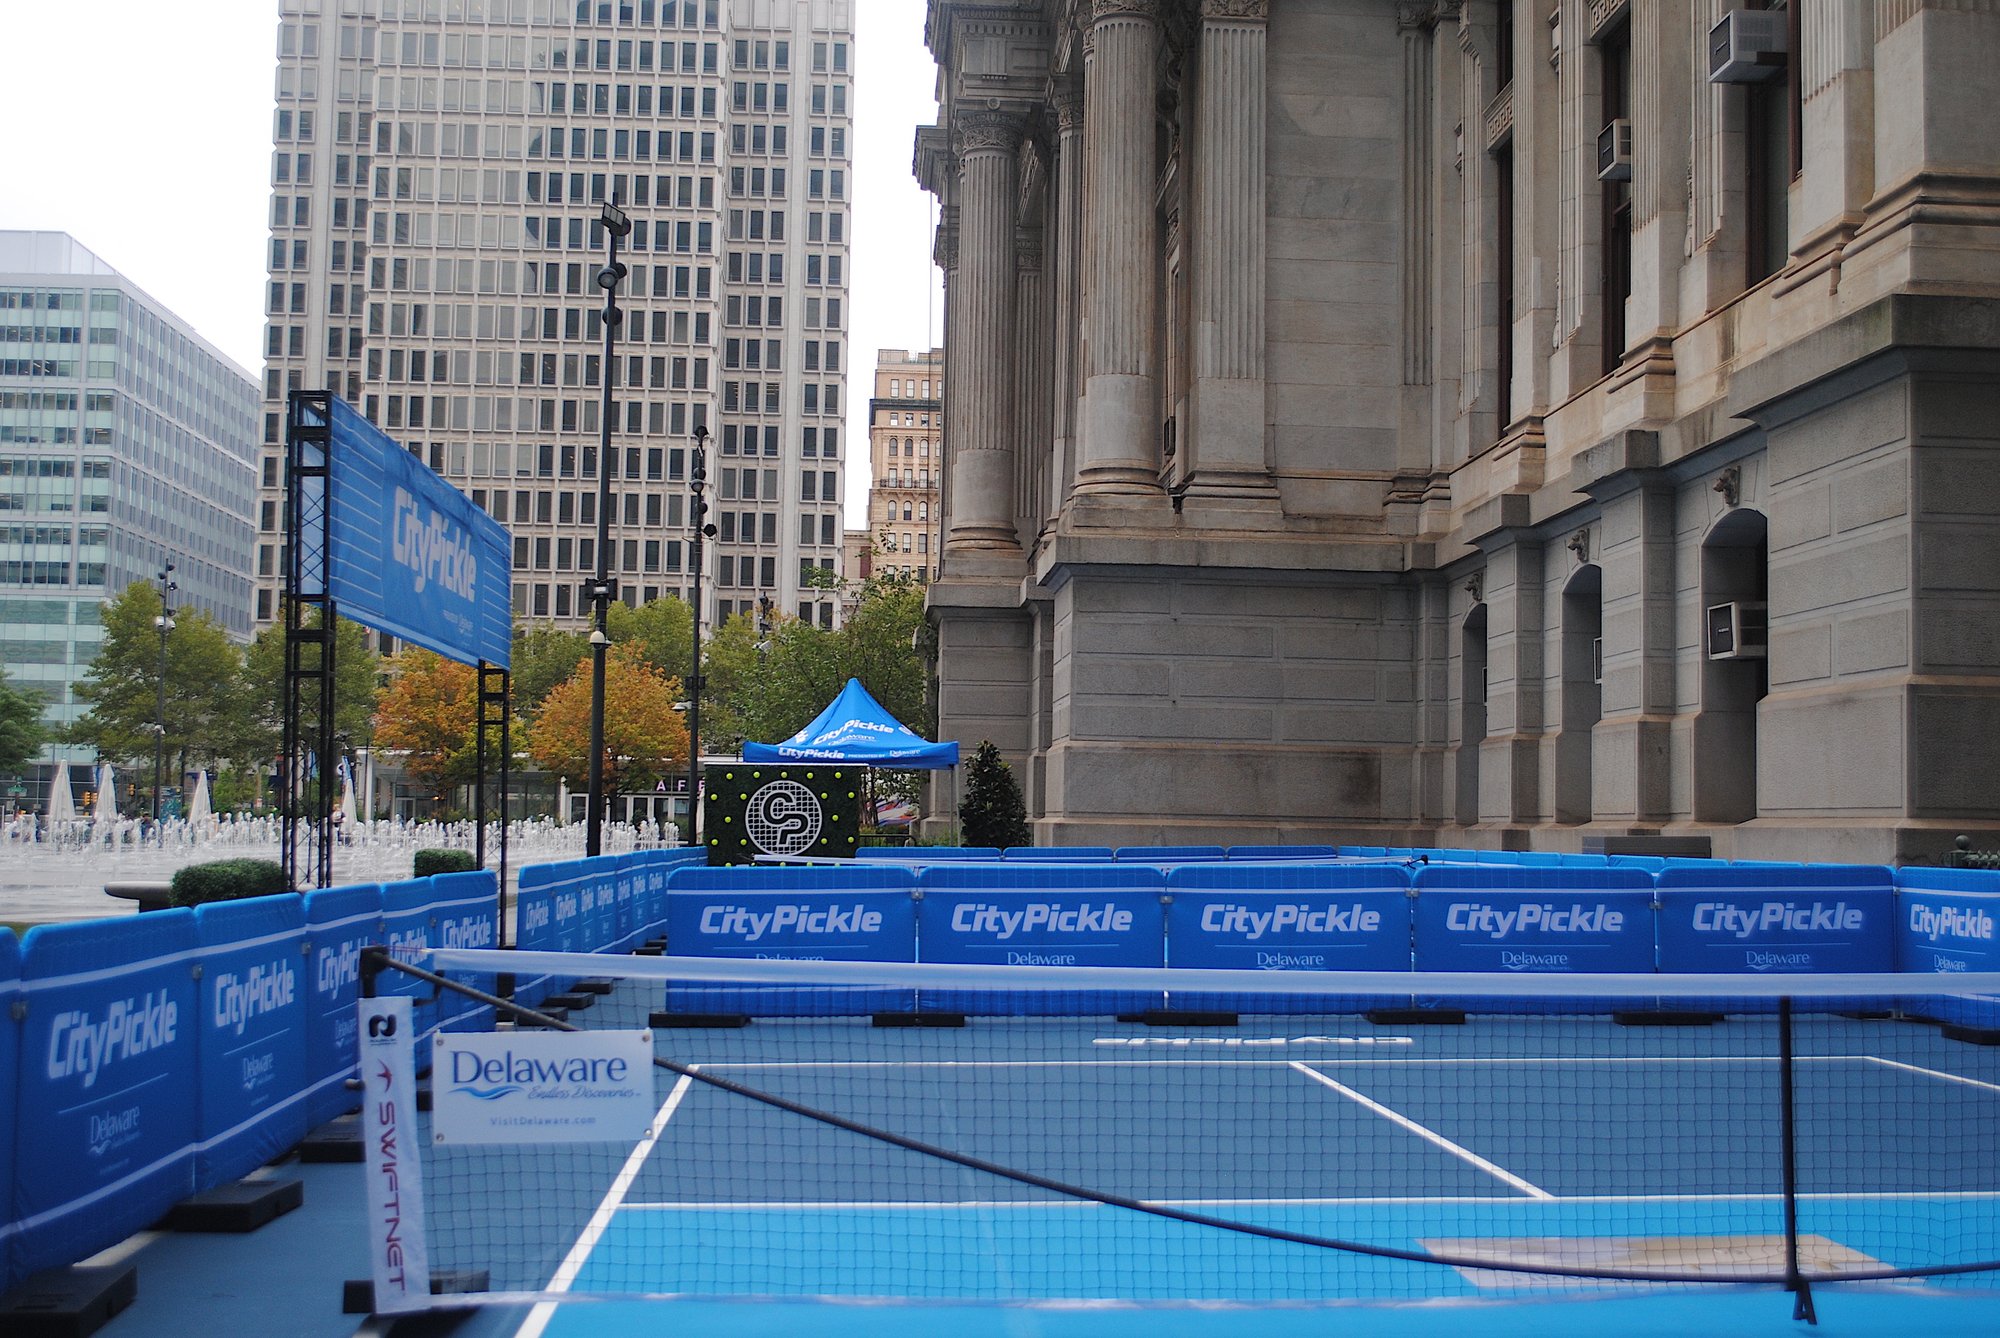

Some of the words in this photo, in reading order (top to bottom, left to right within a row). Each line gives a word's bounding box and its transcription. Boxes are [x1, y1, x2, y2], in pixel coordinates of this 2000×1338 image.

[393, 485, 477, 602] CityPickle
[812, 719, 894, 745] CityPickle
[778, 746, 845, 759] CityPickle
[443, 913, 491, 949] CityPickle
[700, 904, 882, 941] CityPickle
[951, 903, 1133, 939] CityPickle
[1201, 904, 1380, 940] CityPickle
[1446, 903, 1623, 939] CityPickle
[1692, 902, 1863, 938] CityPickle
[1910, 903, 1992, 941] CityPickle
[1007, 951, 1075, 965] Delaware
[1256, 951, 1324, 966] Delaware
[1501, 951, 1568, 965] Delaware
[1745, 951, 1810, 964] Delaware
[1934, 954, 1966, 971] Delaware
[215, 958, 295, 1036] CityPickle
[48, 988, 177, 1088] CityPickle
[450, 1050, 627, 1084] Delaware
[528, 1085, 569, 1100] Endless
[572, 1085, 634, 1099] Discoveries
[90, 1106, 140, 1144] Delaware
[379, 1100, 405, 1292] SWIFTNET
